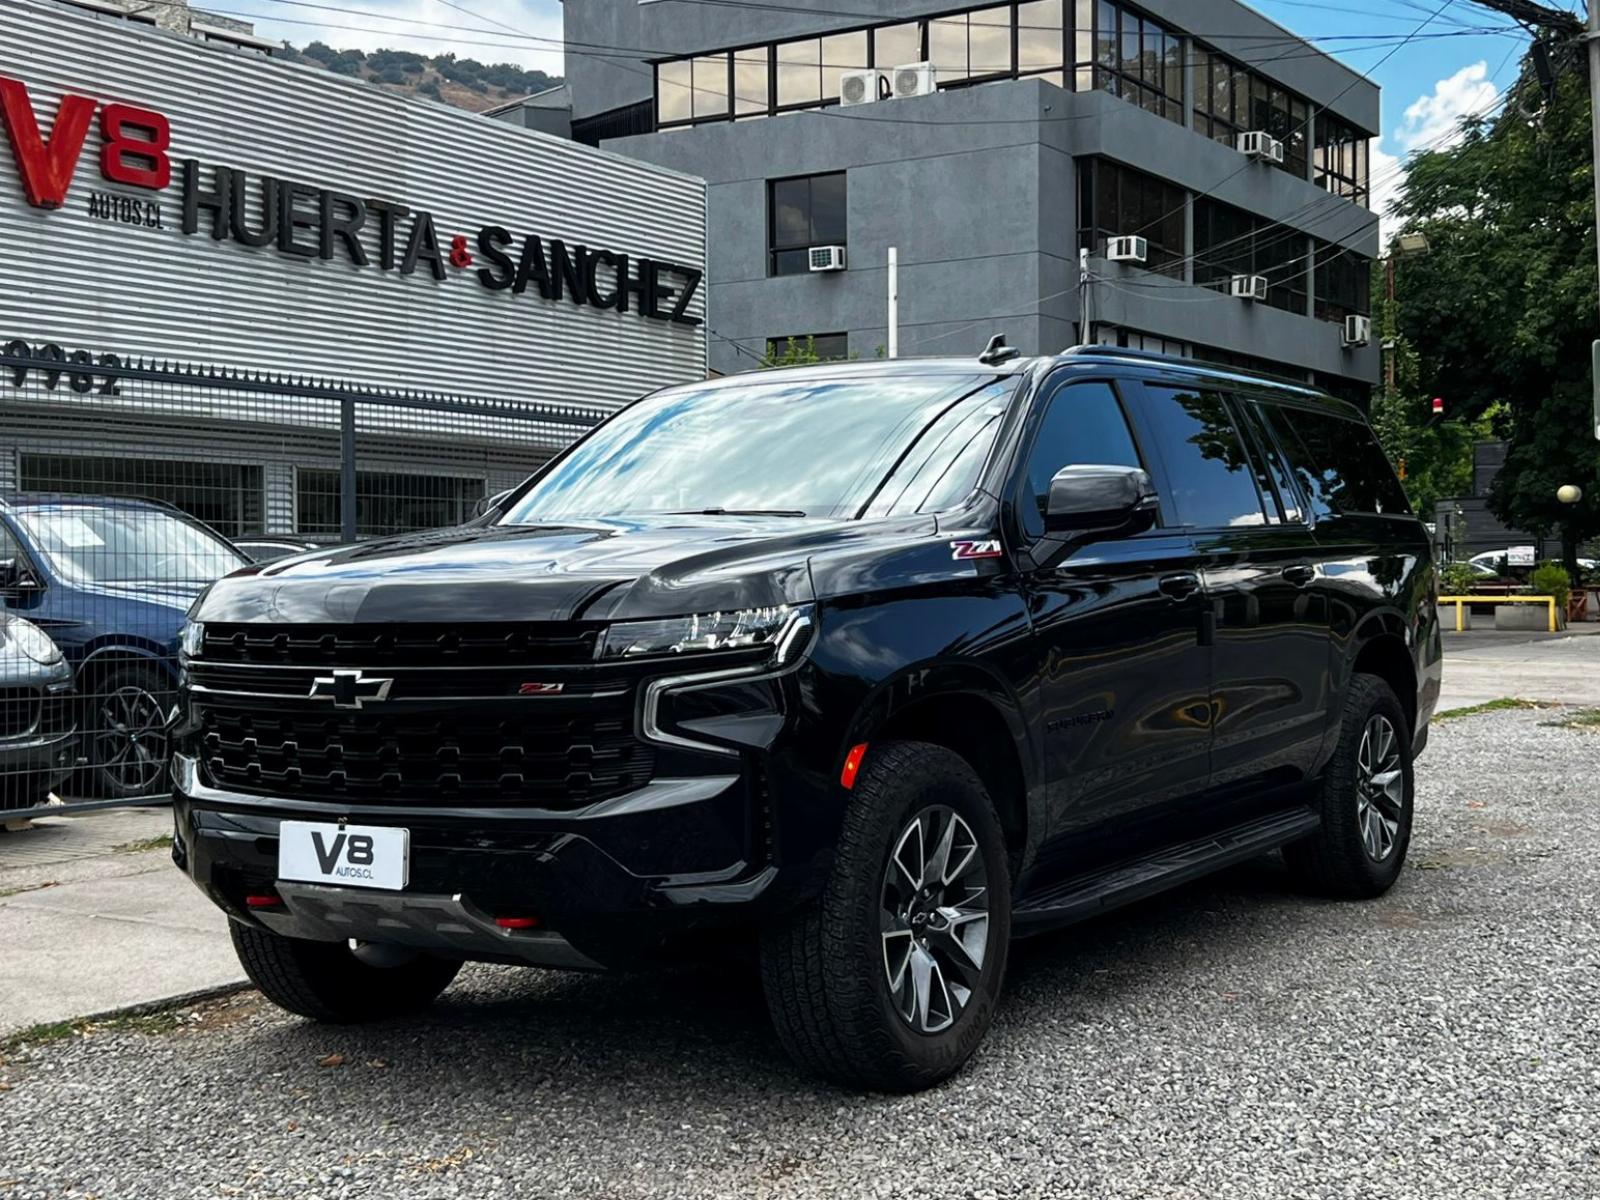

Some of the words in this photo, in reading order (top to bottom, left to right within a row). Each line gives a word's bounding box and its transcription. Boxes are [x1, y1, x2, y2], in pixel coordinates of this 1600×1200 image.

[0, 75, 171, 211] V8
[88, 192, 164, 230] AUTOS.CL
[182, 158, 447, 281] HUERTA
[449, 235, 473, 268] &
[477, 226, 702, 325] SANCHEZ
[311, 831, 374, 875] V8
[335, 866, 374, 879] AUTOS.CL
